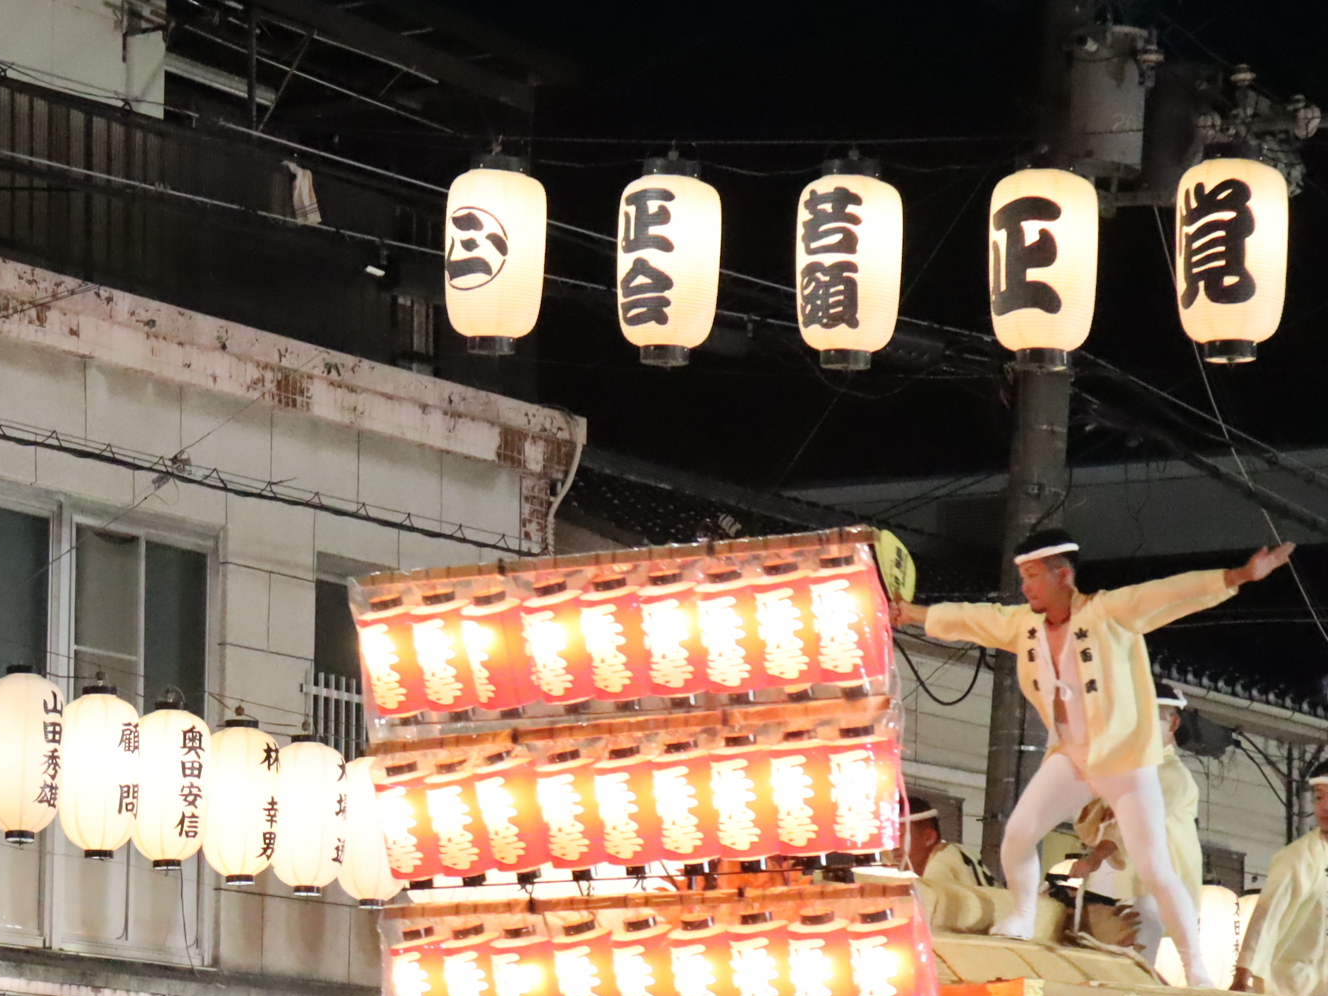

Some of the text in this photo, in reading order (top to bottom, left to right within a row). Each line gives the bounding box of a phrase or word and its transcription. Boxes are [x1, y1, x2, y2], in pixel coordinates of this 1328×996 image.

[622, 187, 675, 326] 正会
[800, 189, 863, 329] 若頭
[990, 197, 1062, 315] 正
[1178, 179, 1257, 309] 覚
[34, 690, 64, 808] 山田秀雄
[117, 721, 140, 820] 顧問
[174, 725, 205, 839] 奥田安信
